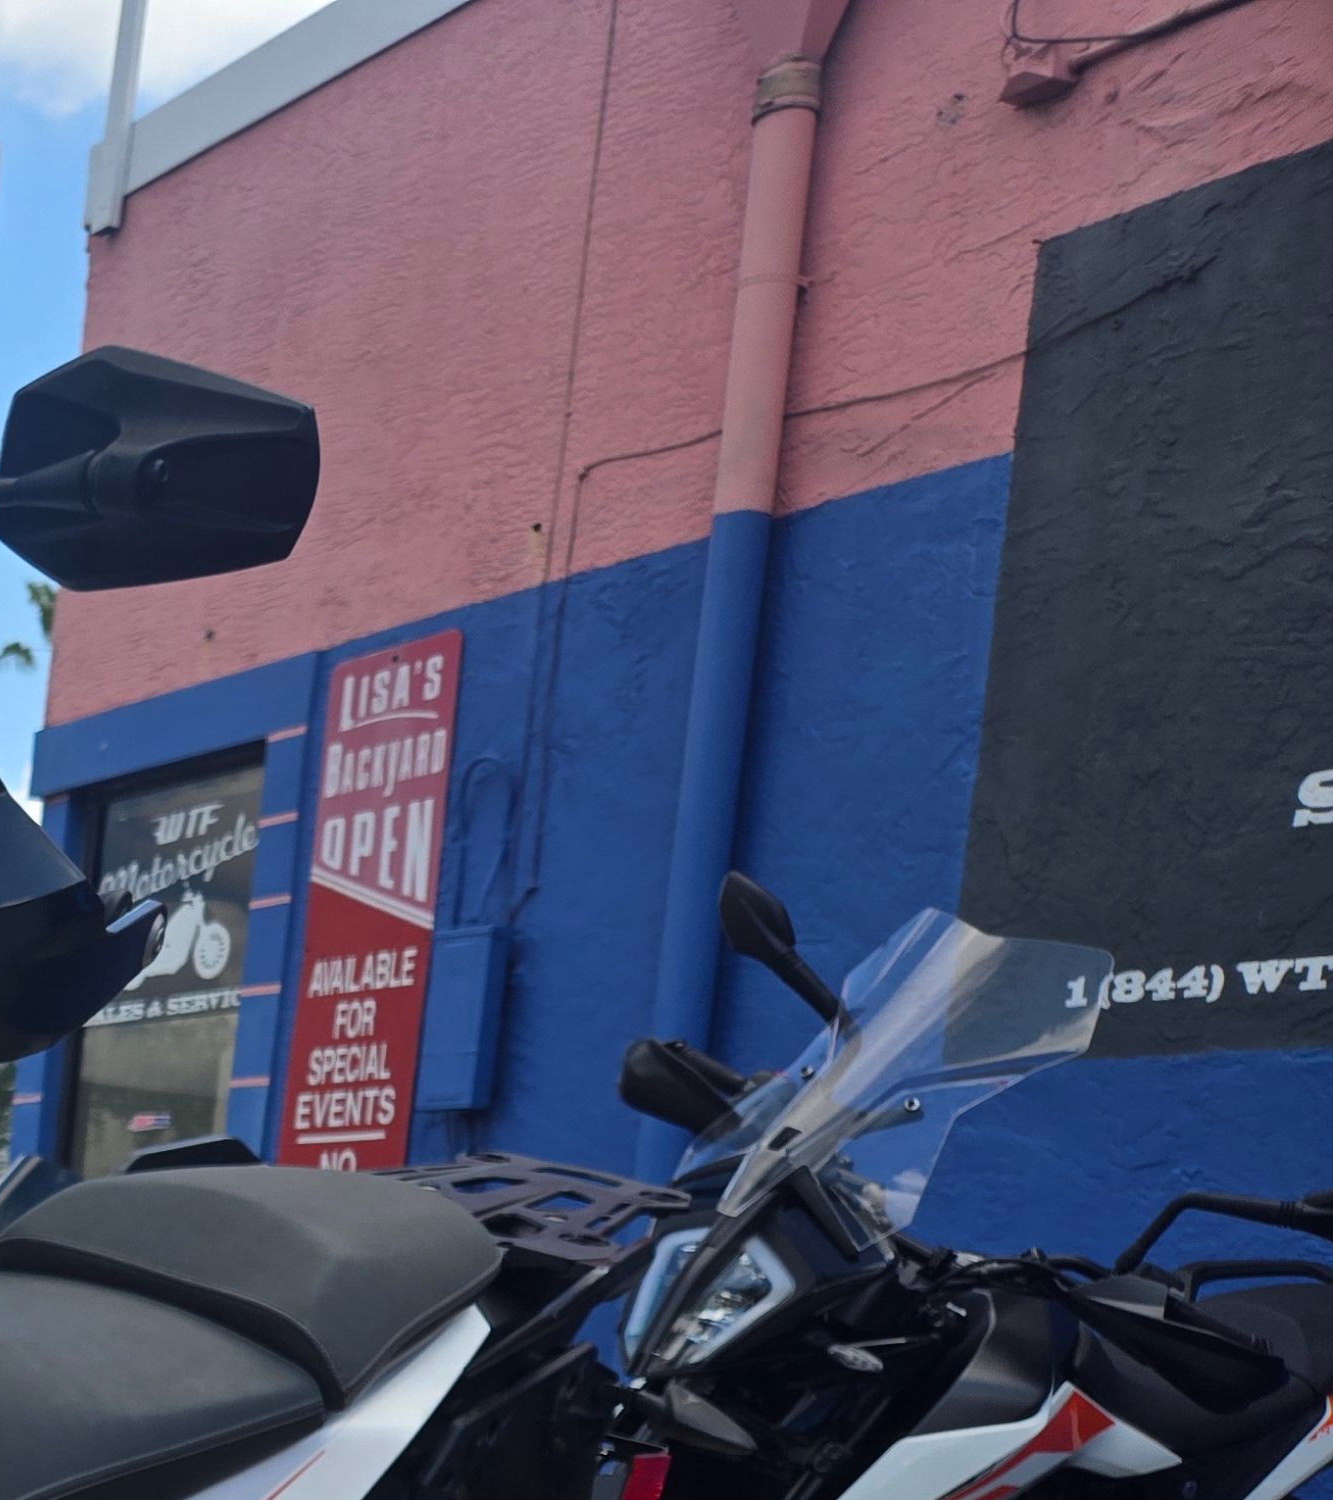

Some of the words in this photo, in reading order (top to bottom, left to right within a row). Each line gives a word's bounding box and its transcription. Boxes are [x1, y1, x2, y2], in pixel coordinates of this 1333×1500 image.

[338, 653, 445, 733] LISA'S
[323, 728, 448, 799] BACKYARD
[1292, 768, 1333, 828] S
[149, 802, 225, 845] WTF
[321, 798, 435, 902] OPEN
[307, 945, 419, 998] AVAILABLE
[1064, 976, 1088, 1009] 1
[1099, 963, 1225, 1010] (844)
[1236, 954, 1333, 995] WT
[146, 1000, 163, 1018] &
[165, 989, 241, 1016] SERVIC
[332, 998, 377, 1040] FOR
[306, 1043, 392, 1087] SPECIAL
[293, 1086, 396, 1130] EVENTS
[318, 1148, 357, 1173] NO
